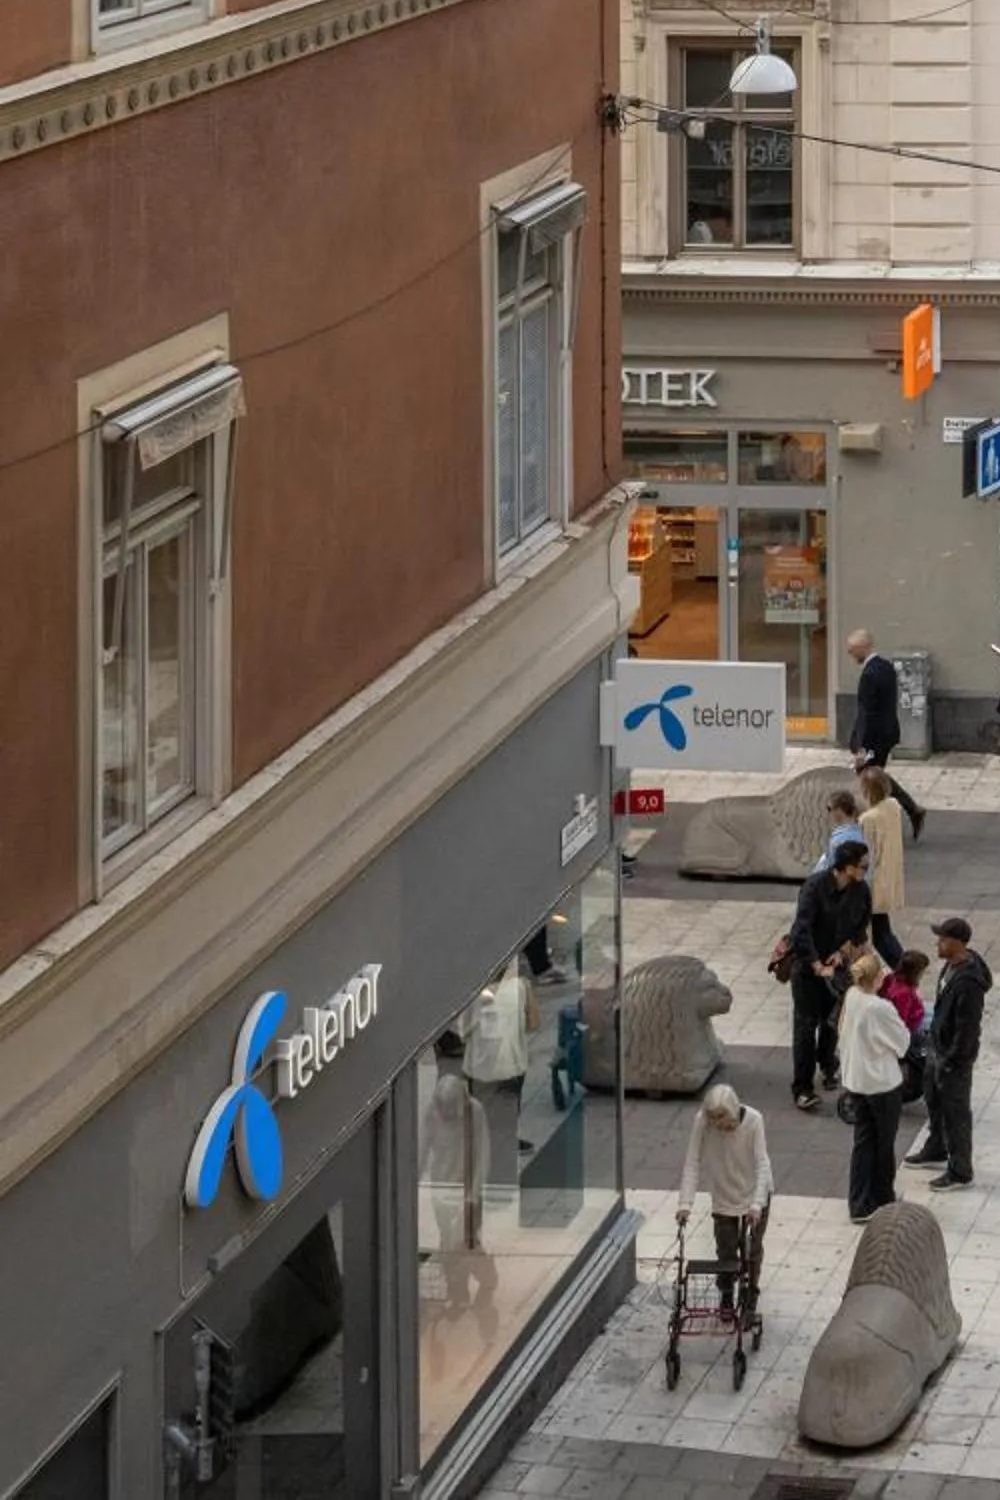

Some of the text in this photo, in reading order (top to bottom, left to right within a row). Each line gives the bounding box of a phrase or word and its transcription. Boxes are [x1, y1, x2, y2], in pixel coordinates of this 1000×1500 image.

[622, 367, 718, 407] TEK
[692, 703, 774, 730] telenor
[279, 964, 382, 1098] telenor
